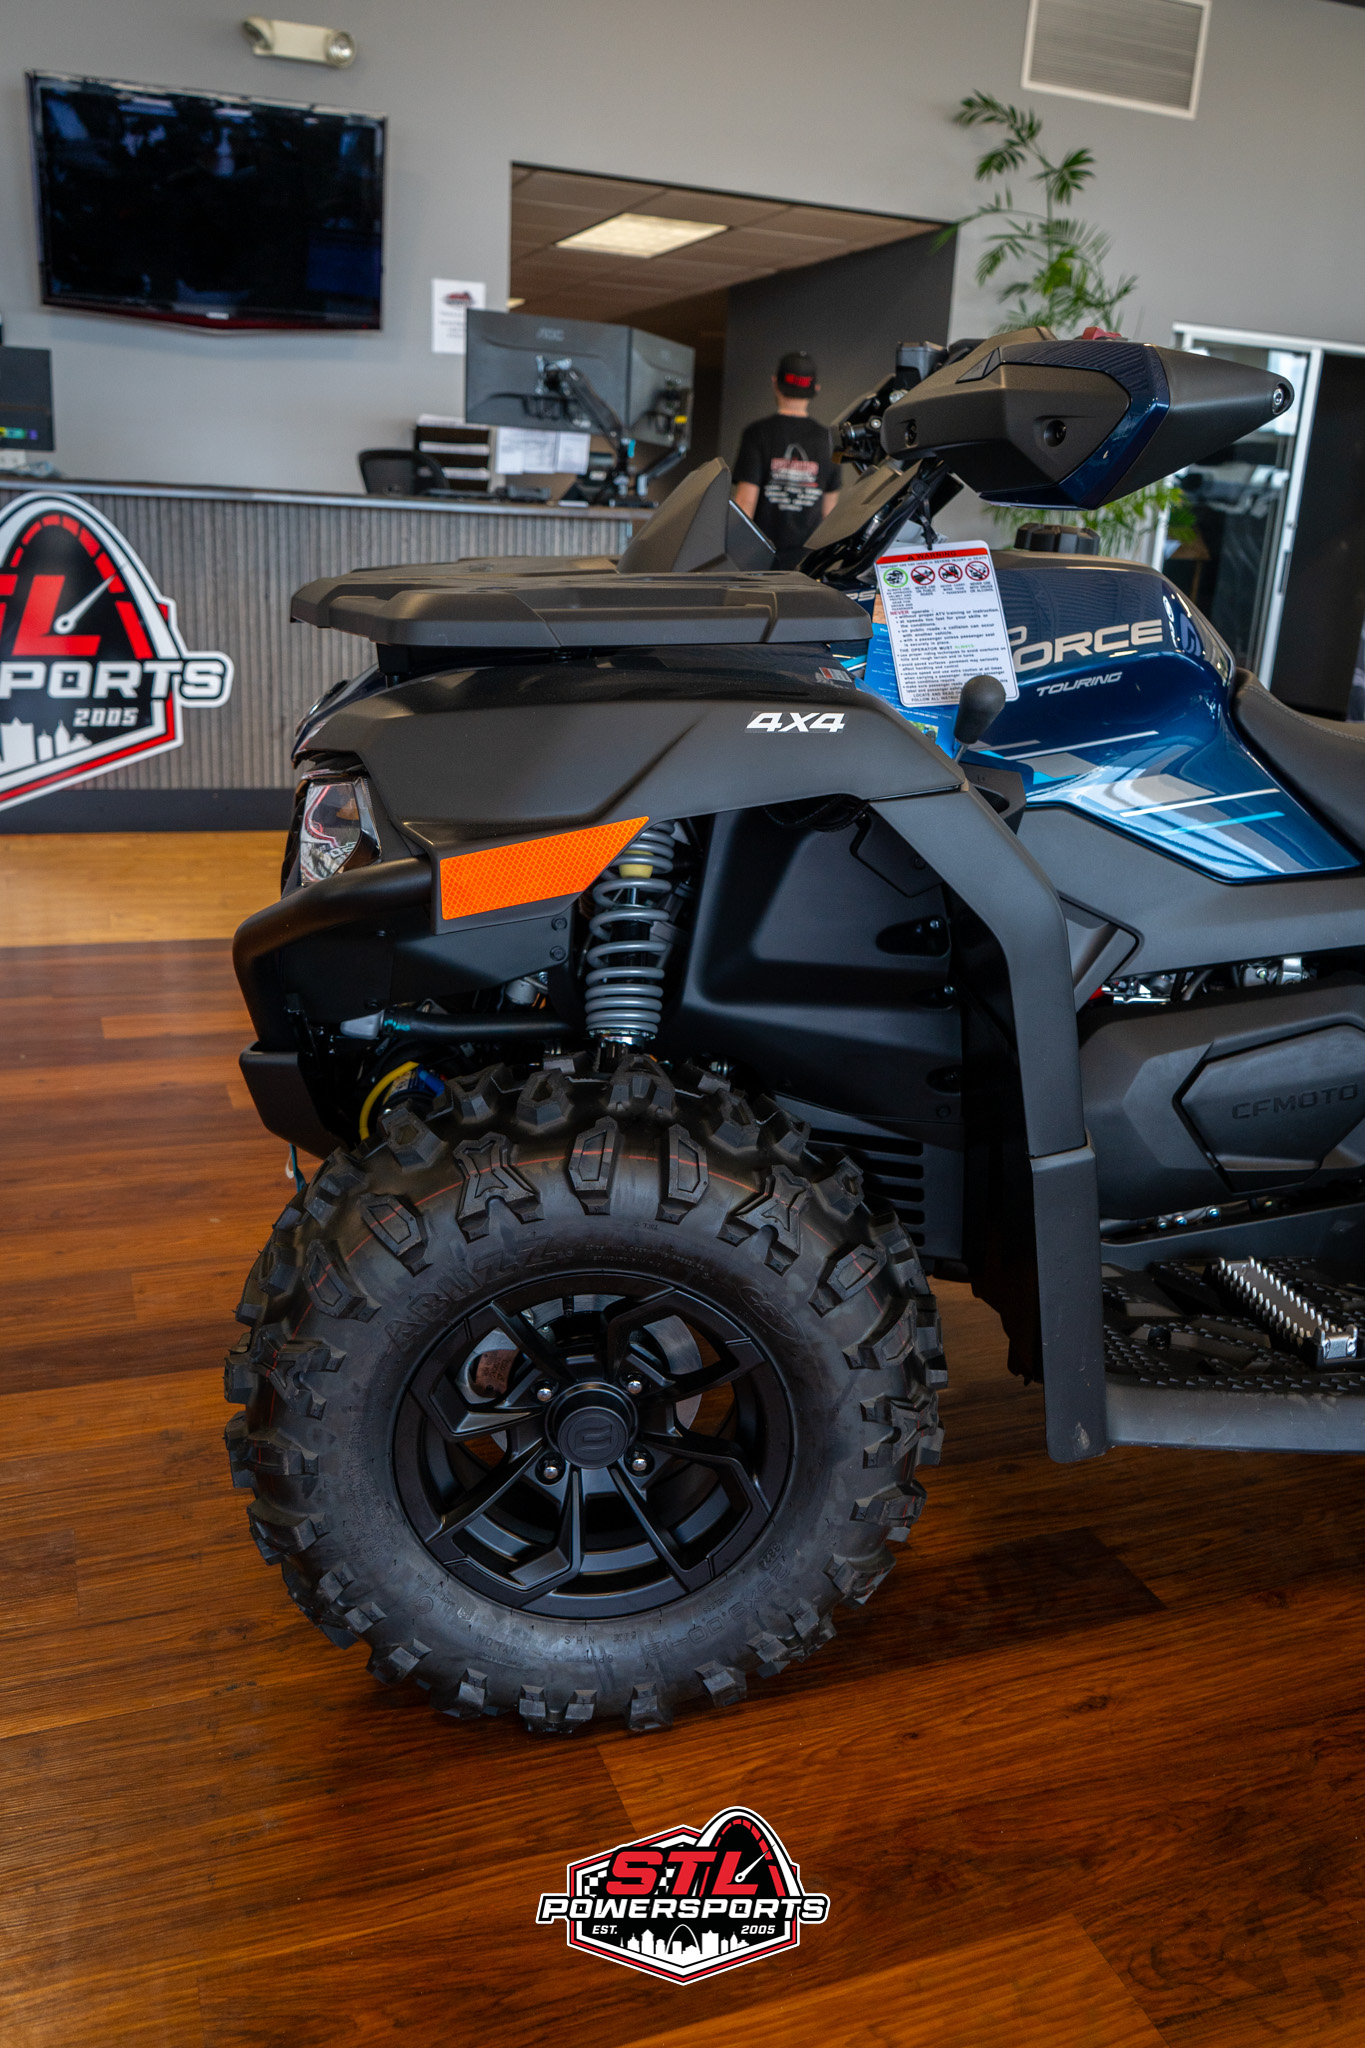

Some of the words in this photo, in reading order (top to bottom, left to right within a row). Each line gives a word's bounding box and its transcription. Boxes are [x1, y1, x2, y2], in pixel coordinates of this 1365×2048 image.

[917, 550, 956, 558] WARNING
[1013, 620, 1162, 672] ORCE
[0, 661, 225, 699] PORTS
[1037, 672, 1122, 696] TOURING
[72, 707, 139, 727] 2005
[747, 712, 845, 732] 4X4
[1232, 1083, 1358, 1119] CFMOTO
[645, 1560, 792, 1658] 25X9.00-12
[474, 1629, 520, 1660] NYLON
